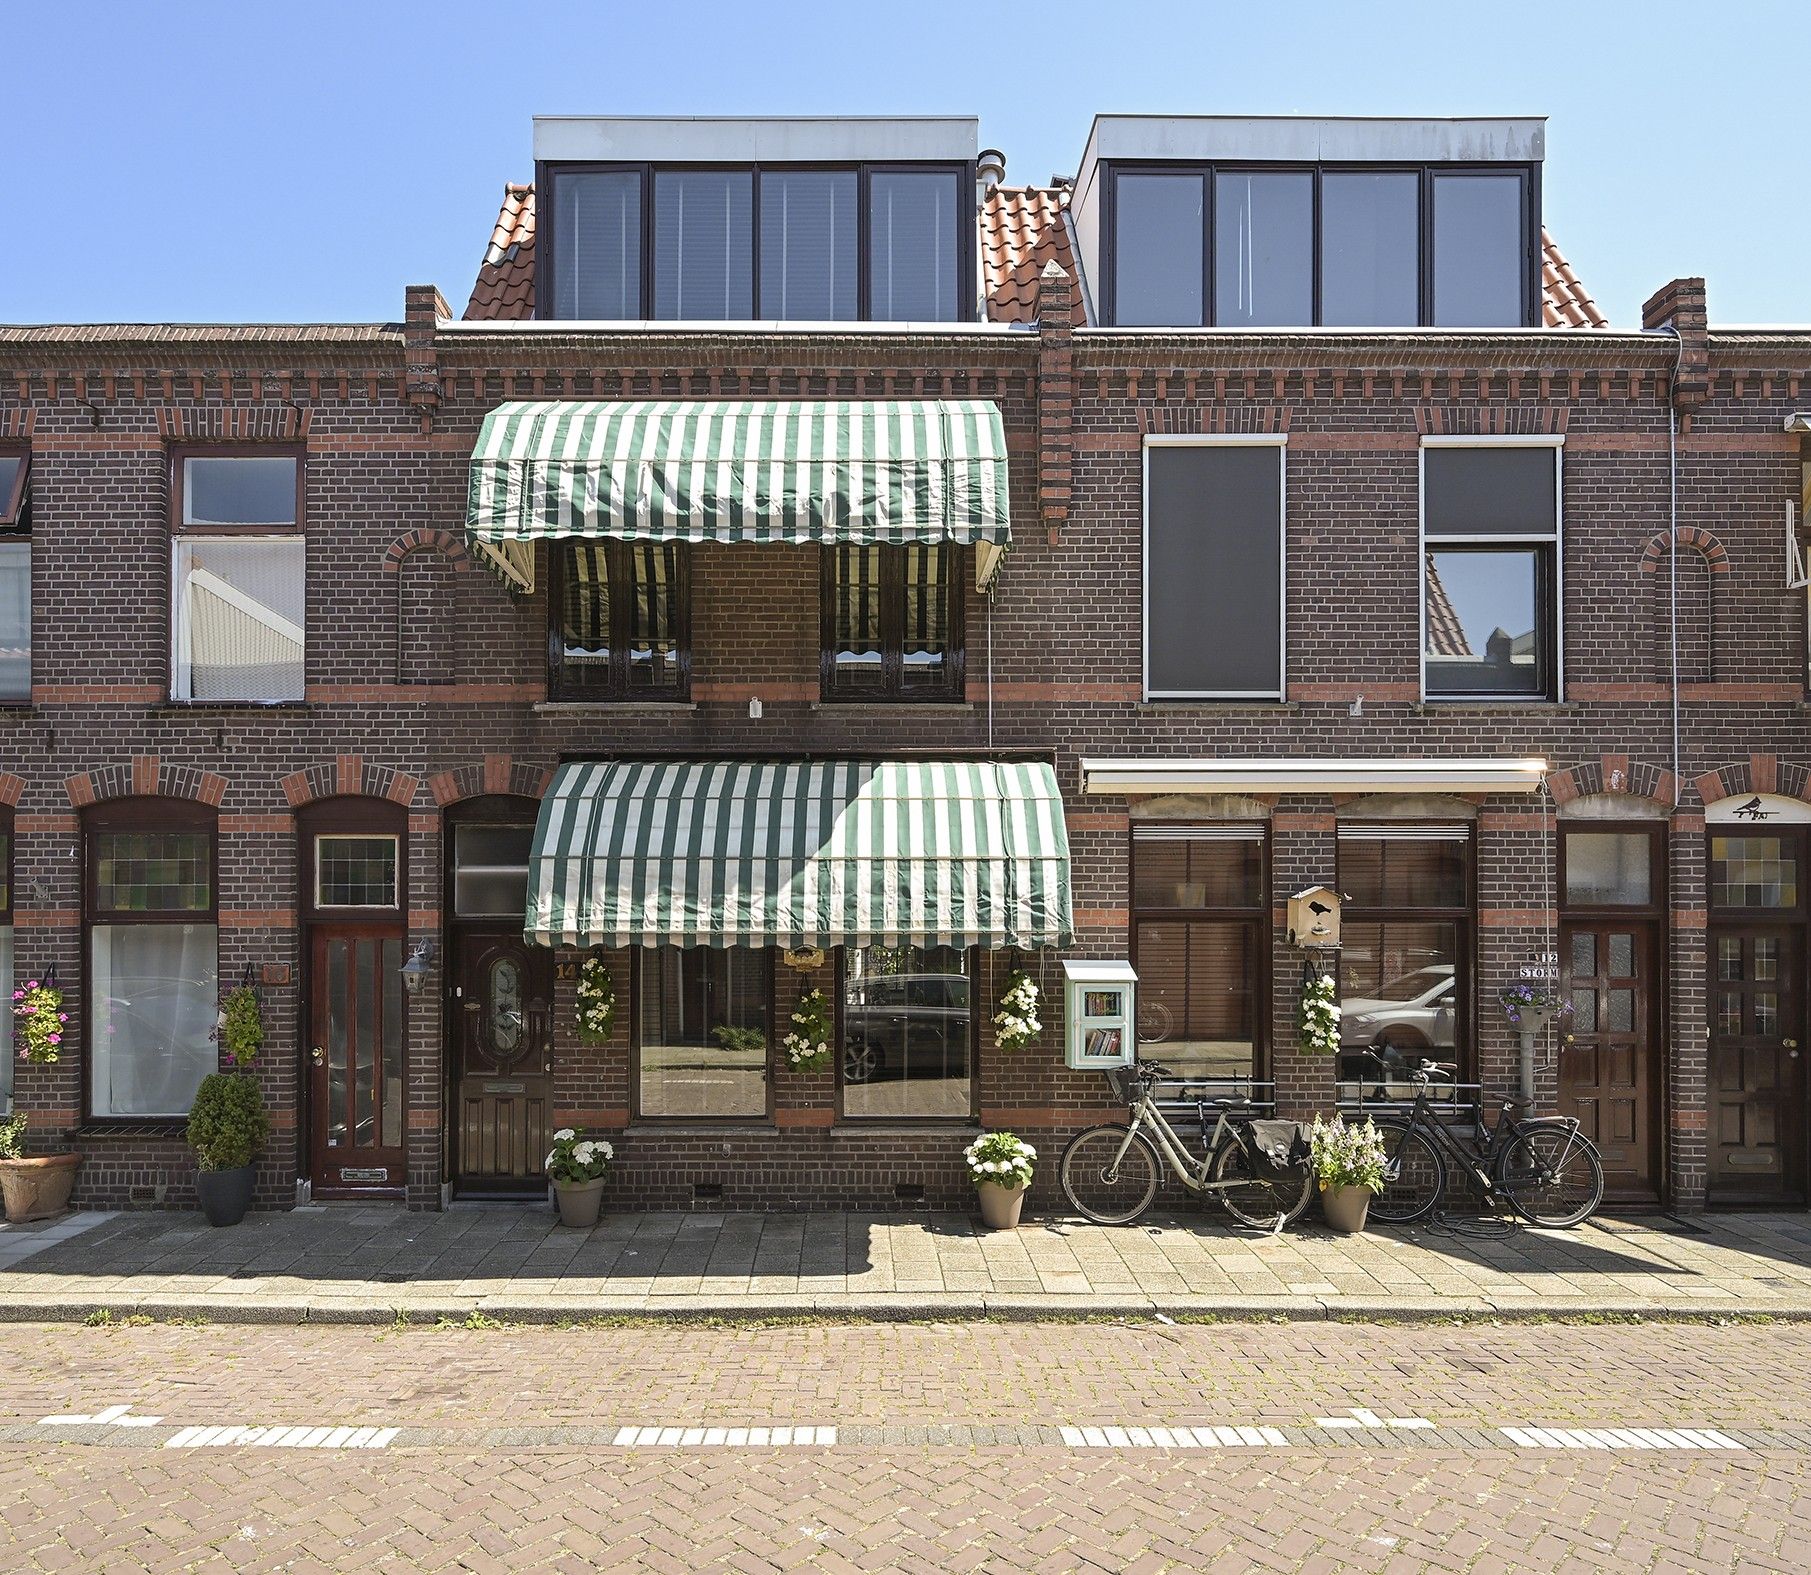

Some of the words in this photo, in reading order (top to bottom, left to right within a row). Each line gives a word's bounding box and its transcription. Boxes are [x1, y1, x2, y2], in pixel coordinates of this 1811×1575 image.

[1543, 953, 1557, 963] 12
[556, 963, 577, 979] 14
[1521, 968, 1557, 978] STORM
